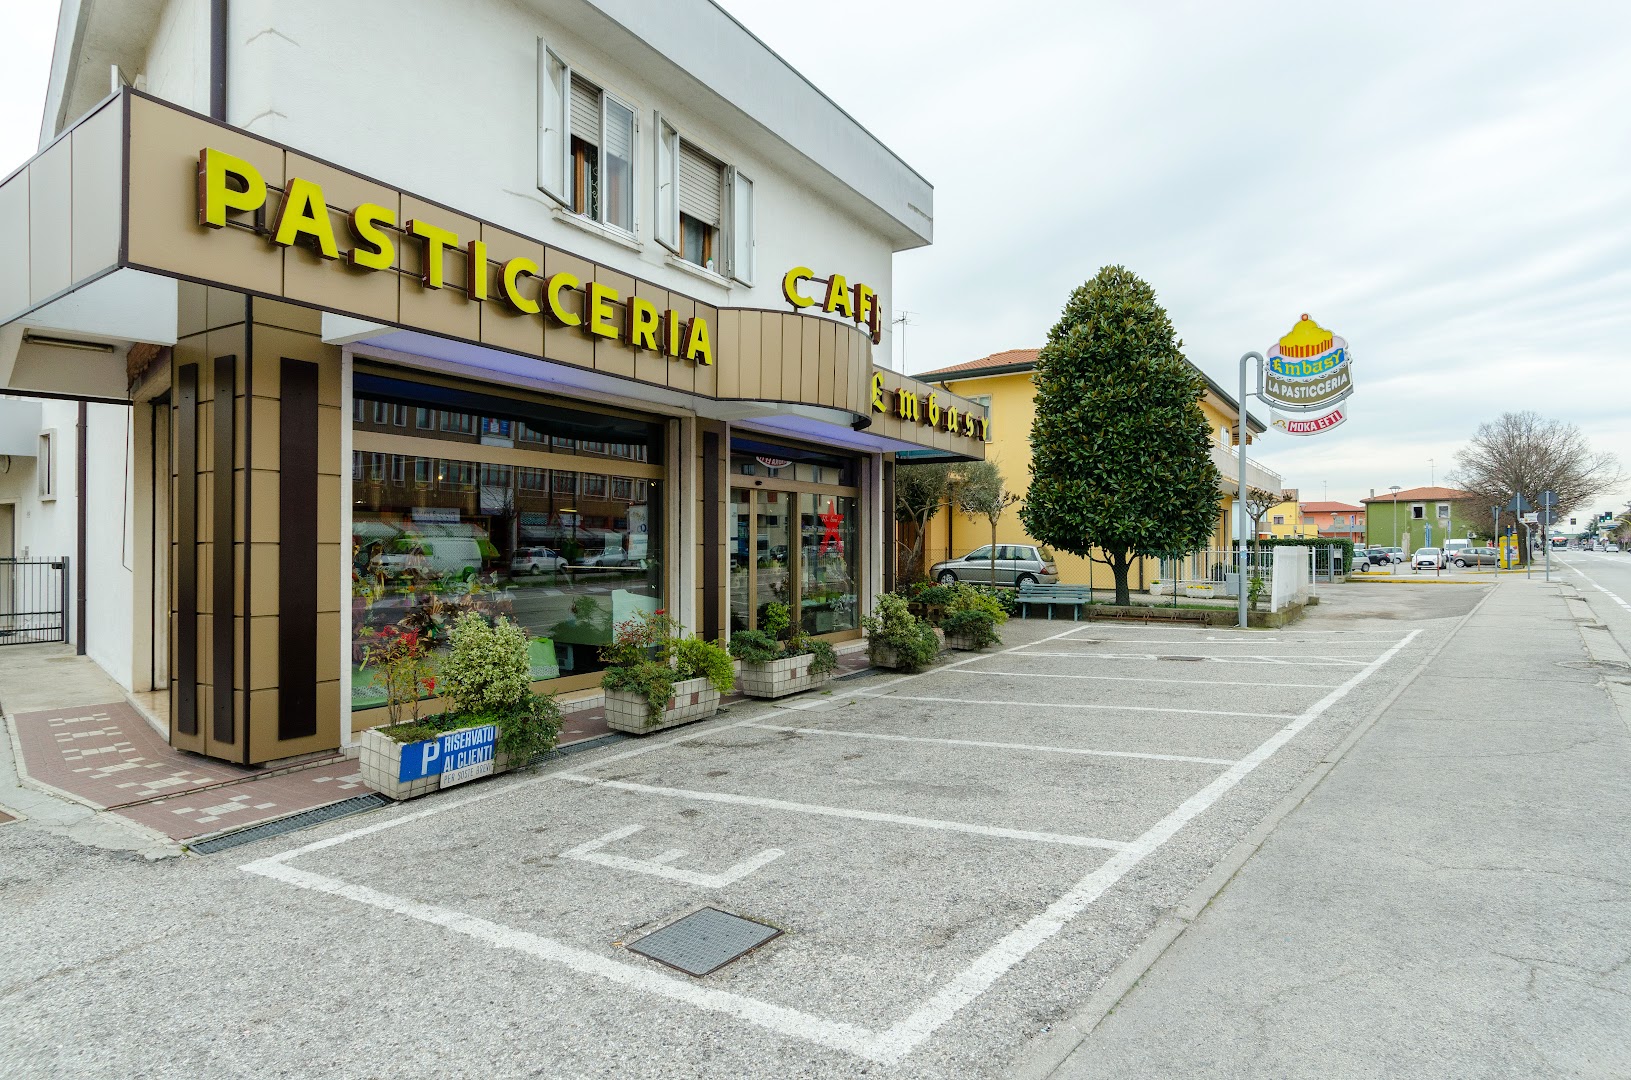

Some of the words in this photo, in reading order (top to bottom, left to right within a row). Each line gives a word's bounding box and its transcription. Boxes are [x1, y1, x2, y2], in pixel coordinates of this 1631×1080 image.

[198, 147, 713, 366] PASTICCERIA
[782, 266, 882, 345] CAFF
[1269, 380, 1279, 394] LA
[1282, 374, 1347, 398] PASTICCERIA
[1290, 421, 1317, 431] MOKA
[1319, 412, 1342, 428] EFTI
[444, 727, 494, 753] RISERVATO
[421, 742, 440, 775] P
[443, 756, 454, 772] AI
[457, 745, 492, 768] CLIENTI
[444, 774, 455, 784] PER
[457, 768, 474, 780] SOSTE
